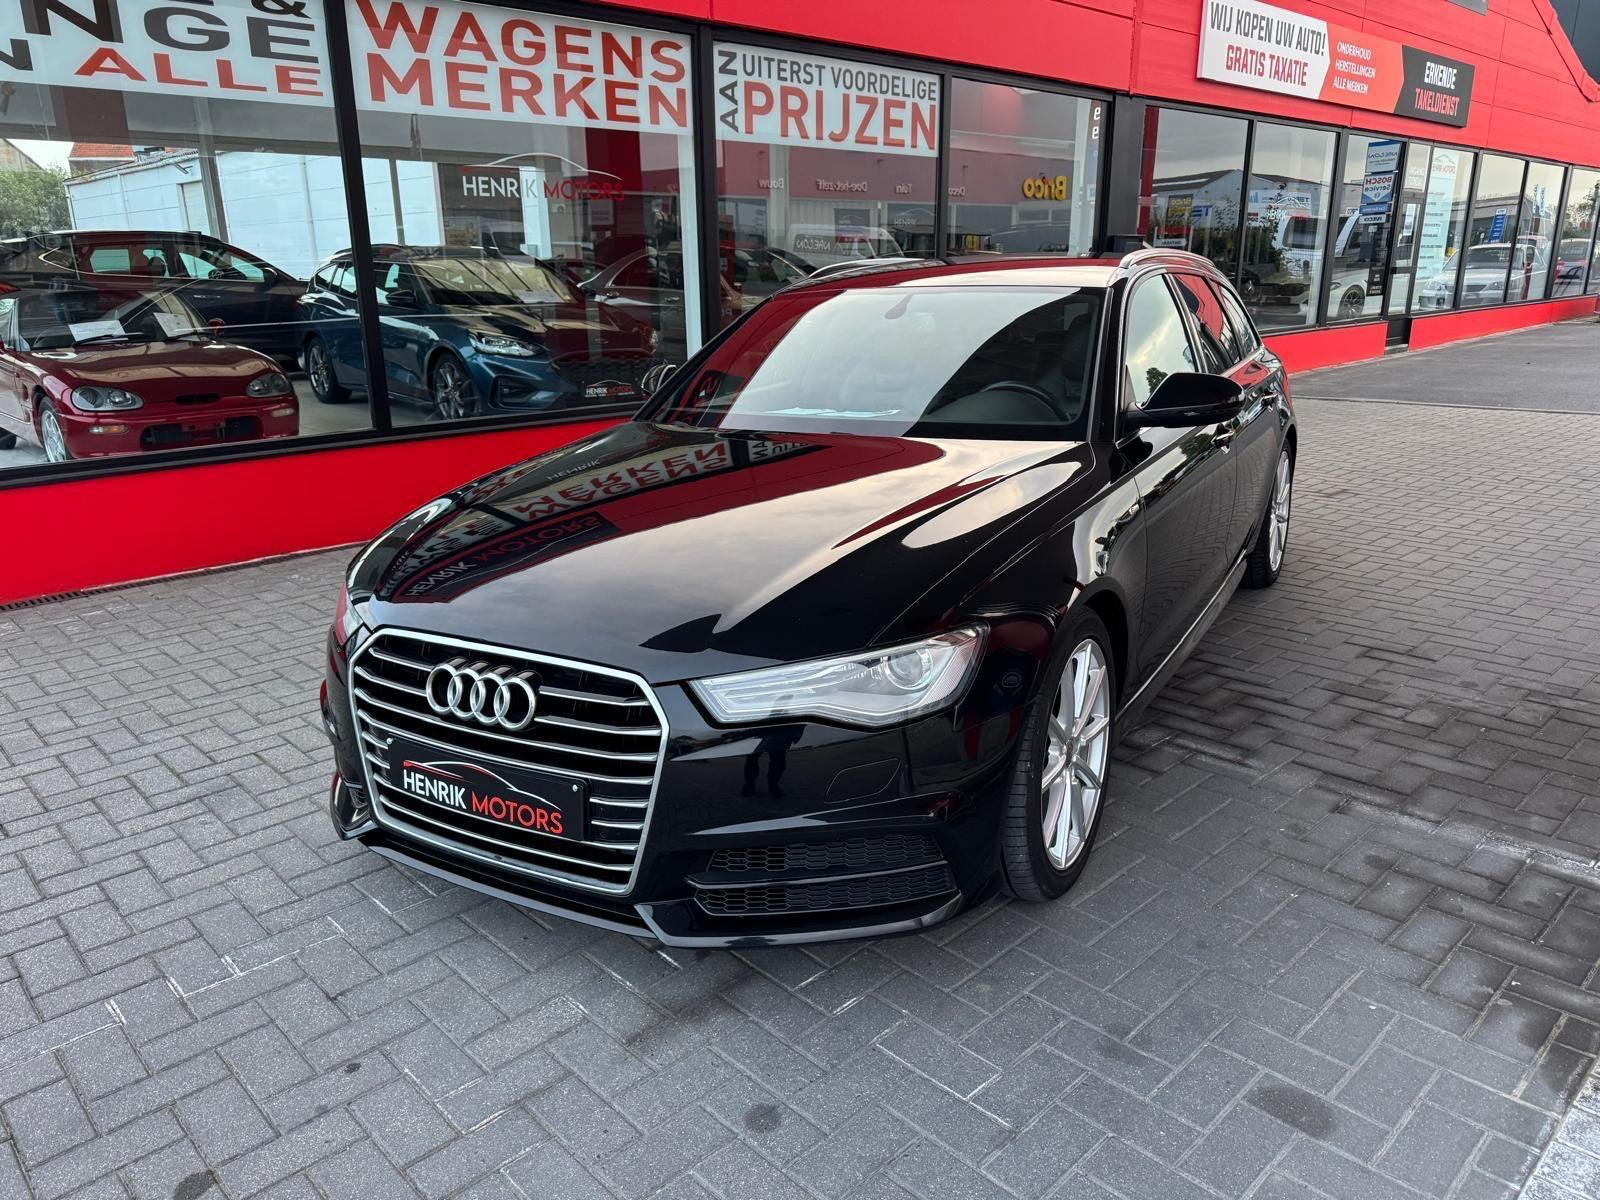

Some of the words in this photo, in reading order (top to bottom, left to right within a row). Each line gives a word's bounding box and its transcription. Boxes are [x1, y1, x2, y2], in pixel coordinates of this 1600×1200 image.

[356, 0, 686, 84] WAGENS
[1209, 1, 1233, 33] WIJ
[1235, 8, 1274, 43] KOPEN
[1275, 20, 1296, 48] UW
[1295, 26, 1326, 56] AUTO!
[1336, 42, 1372, 60] ONDERHOUD
[74, 47, 324, 97] ALLE
[366, 53, 688, 128] MERKEN
[742, 53, 825, 87] UITERST
[830, 66, 937, 101] VOORDELIGE
[1225, 44, 1266, 77] GRATIS
[1268, 54, 1308, 87] TAXATIE
[1332, 75, 1347, 89] ALLE
[1346, 80, 1369, 94] MERKEN
[1335, 59, 1376, 79] HERSTELLINGEN
[1423, 61, 1457, 90] ERKENDE
[718, 50, 739, 133] AAN
[1414, 88, 1460, 117] TAKELDIENST
[743, 80, 937, 150] PRIJZEN
[462, 175, 535, 198] HENRIK
[543, 180, 624, 202] MOTORS
[402, 769, 467, 809] HENRIK
[471, 791, 564, 834] MOTORS
